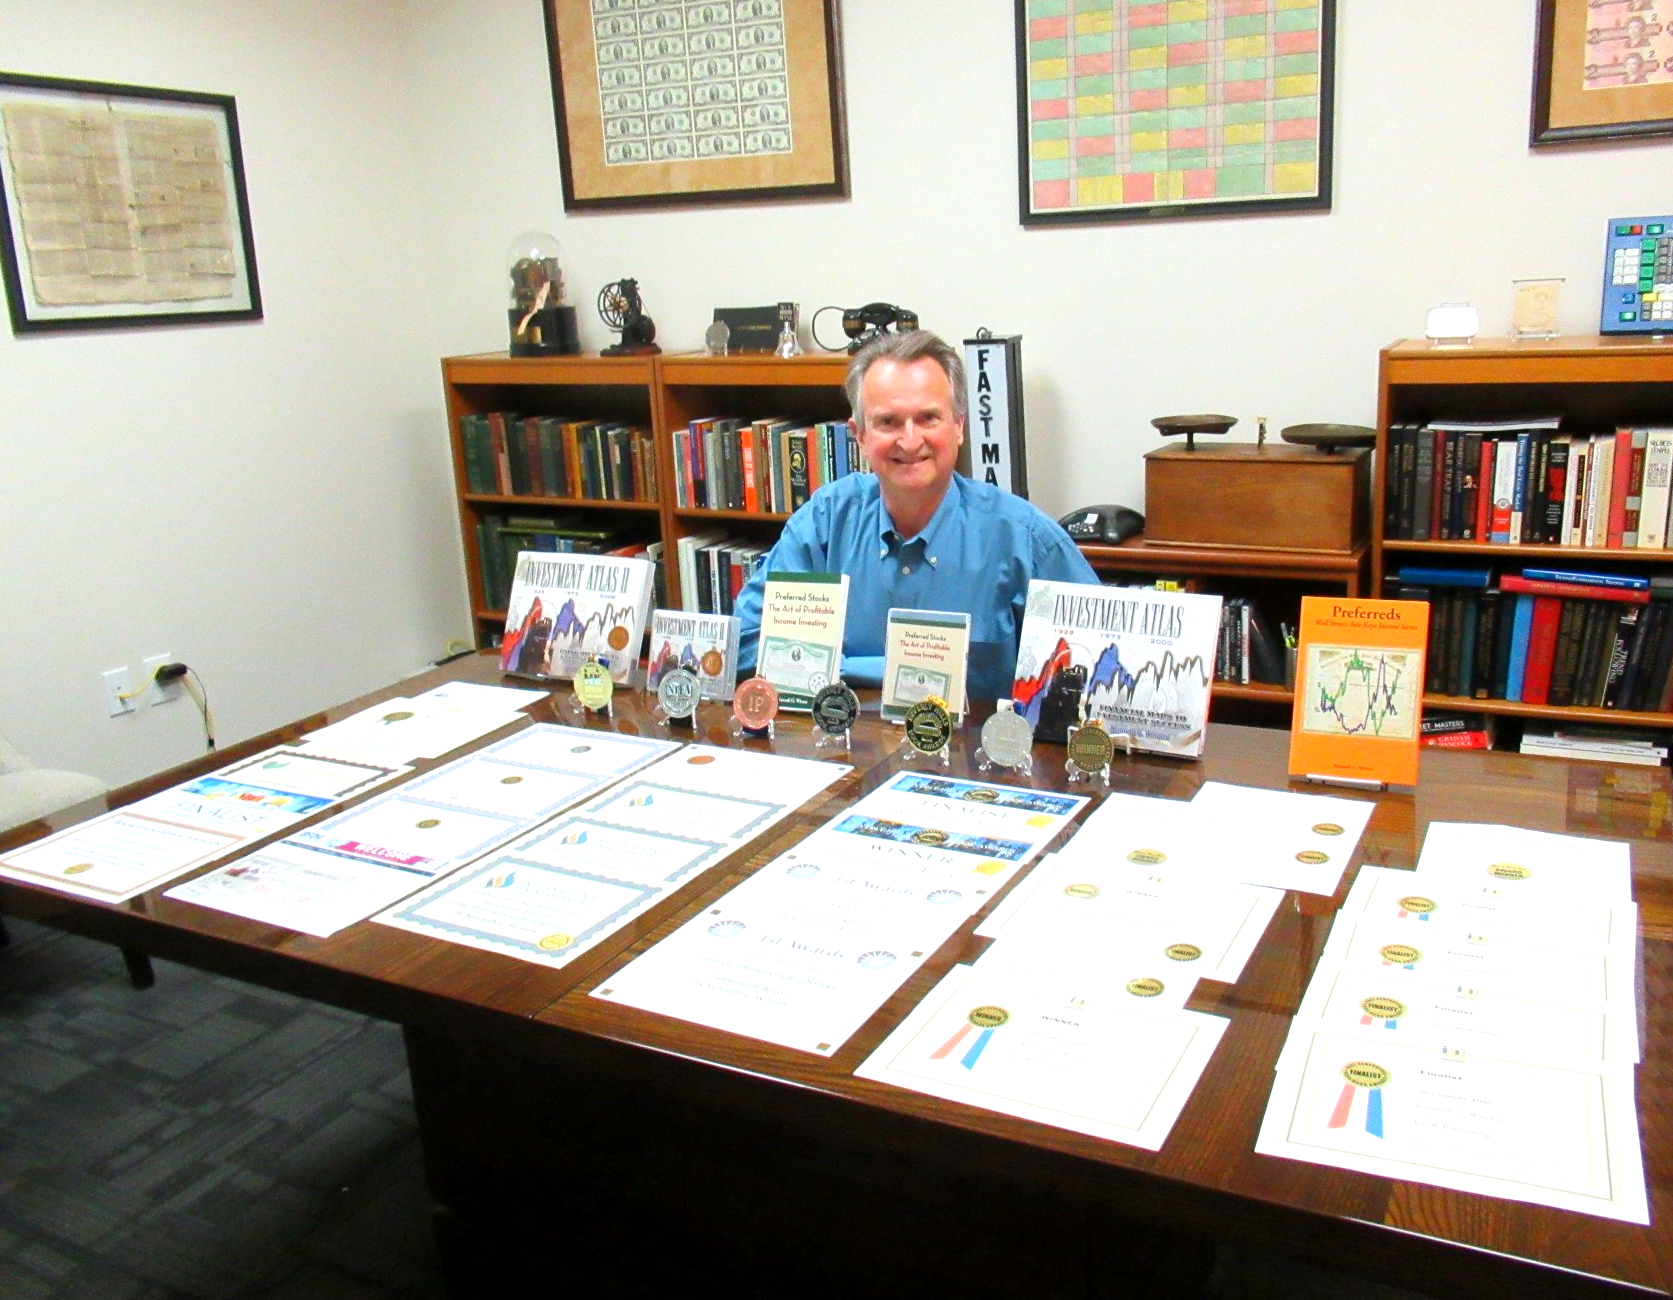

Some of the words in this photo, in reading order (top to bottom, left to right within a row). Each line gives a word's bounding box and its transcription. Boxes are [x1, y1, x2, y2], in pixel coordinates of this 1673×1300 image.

[977, 350, 993, 438] FAST
[525, 560, 586, 590] INVESTMENT
[586, 564, 619, 594] ATLAS
[775, 592, 806, 602] Preferred
[808, 593, 830, 602] Stocks
[768, 604, 780, 612] The
[782, 605, 794, 613] Art
[795, 605, 802, 613] of
[803, 605, 835, 615] Profitable
[1332, 605, 1401, 621] Preferreds
[1052, 594, 1140, 633] INVESTMENT
[1139, 602, 1185, 638] ATLAS
[657, 616, 696, 638] INVESTMENT
[698, 620, 719, 640] ATLAS
[774, 617, 796, 625] Income
[799, 618, 827, 629] Investing
[905, 632, 929, 640] Preferred
[900, 640, 910, 648] The
[926, 642, 950, 651] Profitable
[923, 653, 944, 661] Investing
[1100, 705, 1144, 716] FINANCIAL
[1147, 710, 1173, 720] MAPS
[1151, 719, 1191, 730] SUCCESS
[1435, 720, 1464, 728] MASTERS
[170, 801, 268, 824] FINALIST
[354, 843, 411, 861] WELCOME
[1368, 1002, 1398, 1012] FINALIST
[1042, 1016, 1080, 1026] WINNER
[1350, 1070, 1381, 1079] FINALIST
